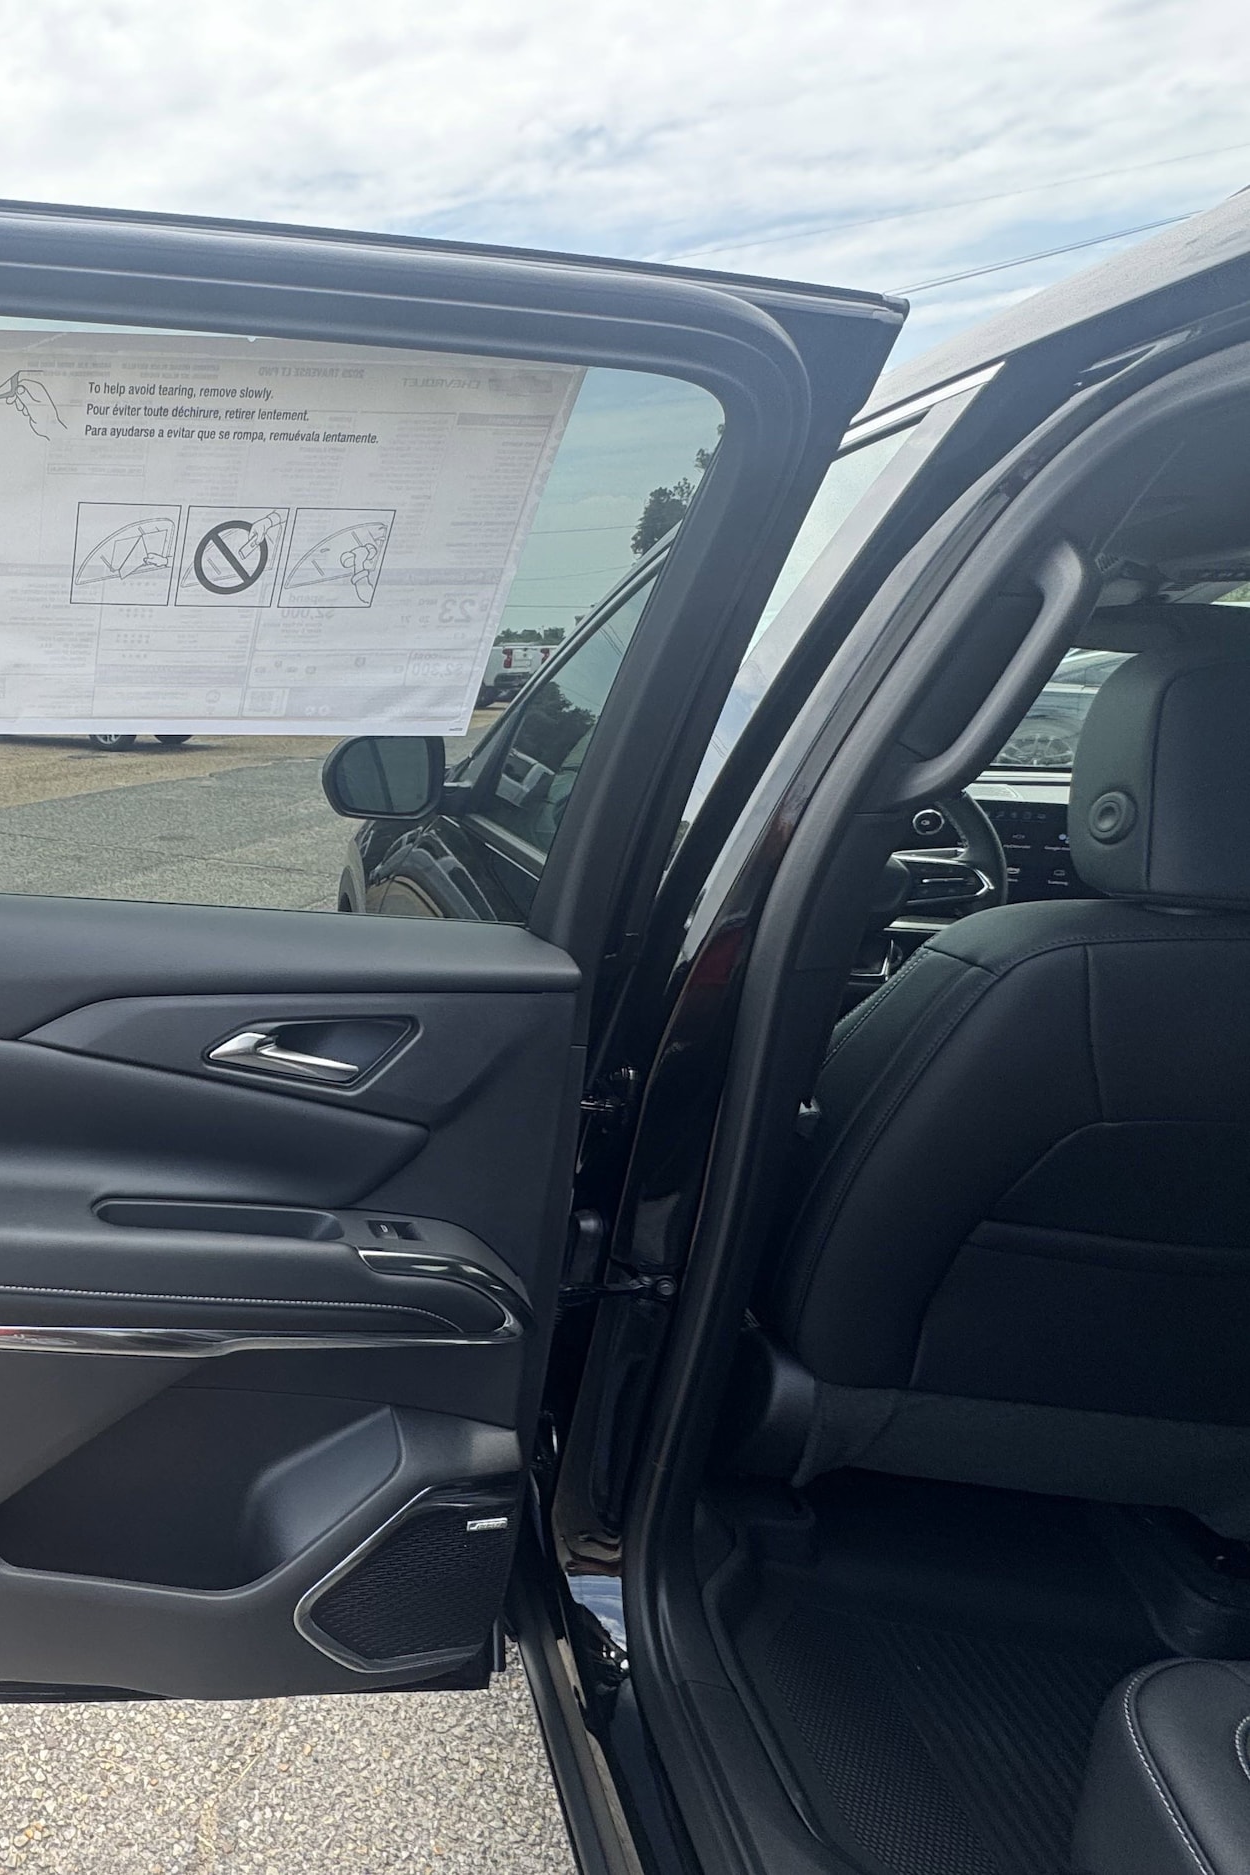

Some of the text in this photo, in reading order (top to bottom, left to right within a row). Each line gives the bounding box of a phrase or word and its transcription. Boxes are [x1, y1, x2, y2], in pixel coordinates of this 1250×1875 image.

[88, 382, 274, 401] To help avoid tearing, remove slowly.
[86, 403, 310, 422] Pour éviter toute déchirure, retirer lentement.
[85, 425, 380, 444] Para ayudarse a evitar que se rompa, remuévala lentamente.
